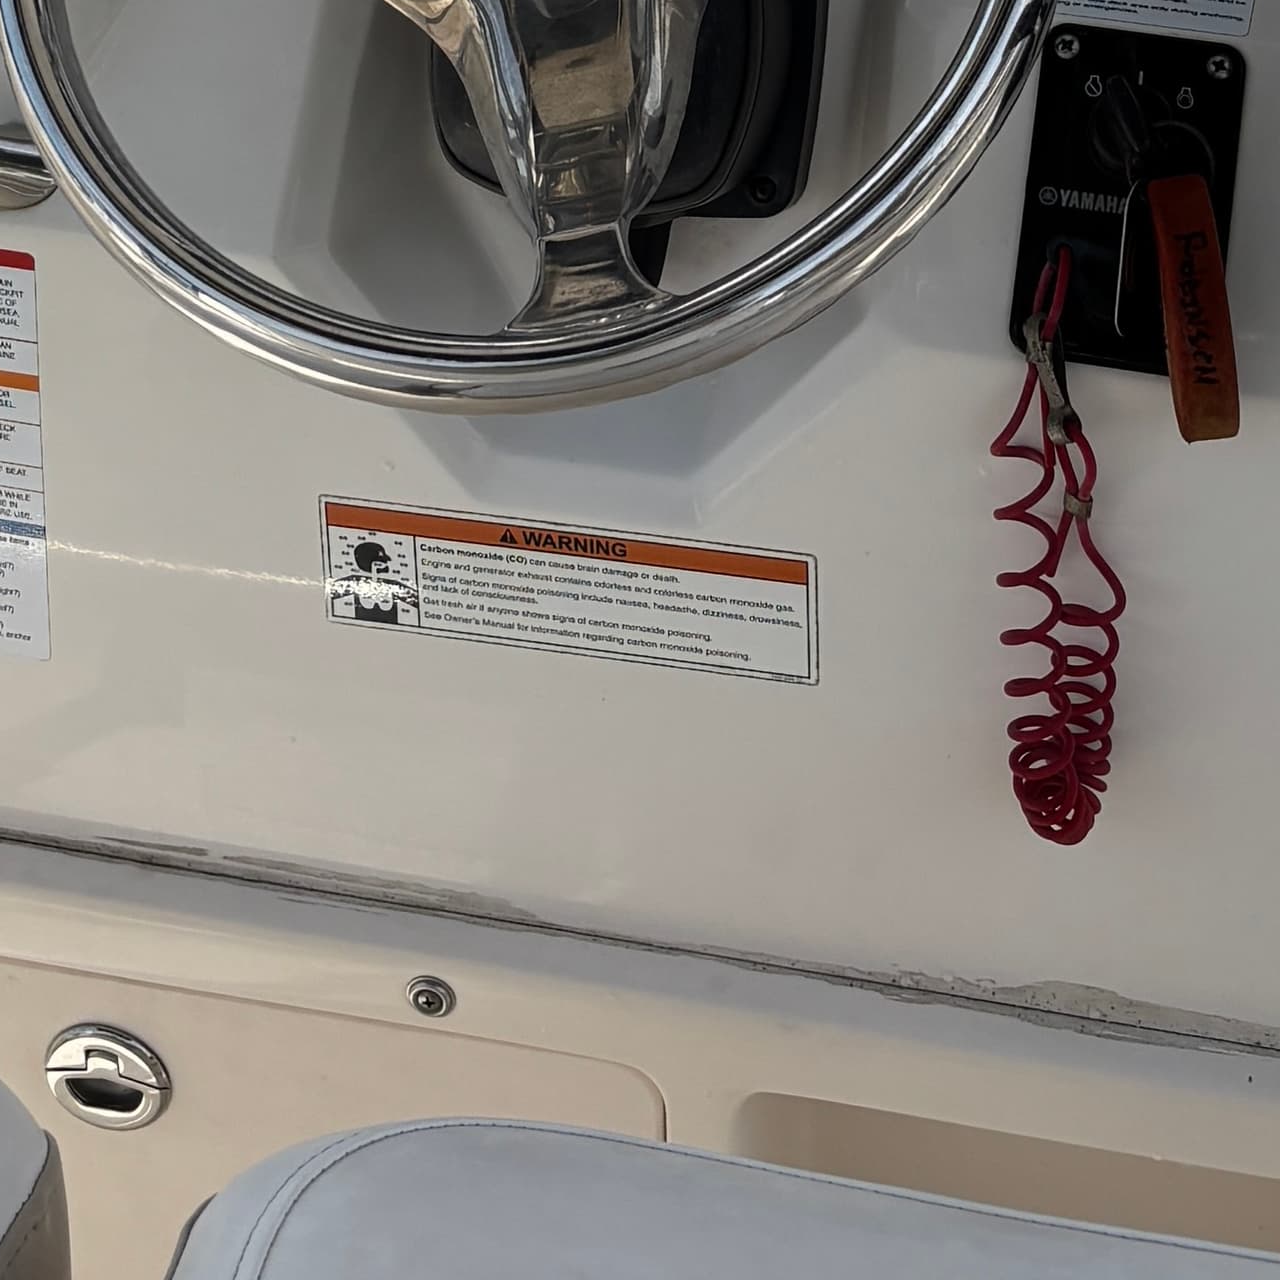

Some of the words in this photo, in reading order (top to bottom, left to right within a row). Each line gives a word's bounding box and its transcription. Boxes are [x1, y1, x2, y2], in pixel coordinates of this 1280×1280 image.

[419, 542, 454, 556] Carbon
[456, 547, 504, 562] monoxide
[505, 553, 527, 565] (CO)
[529, 556, 546, 568] can
[547, 558, 575, 572] cause
[576, 562, 600, 575] brain
[522, 530, 627, 558] WARNING
